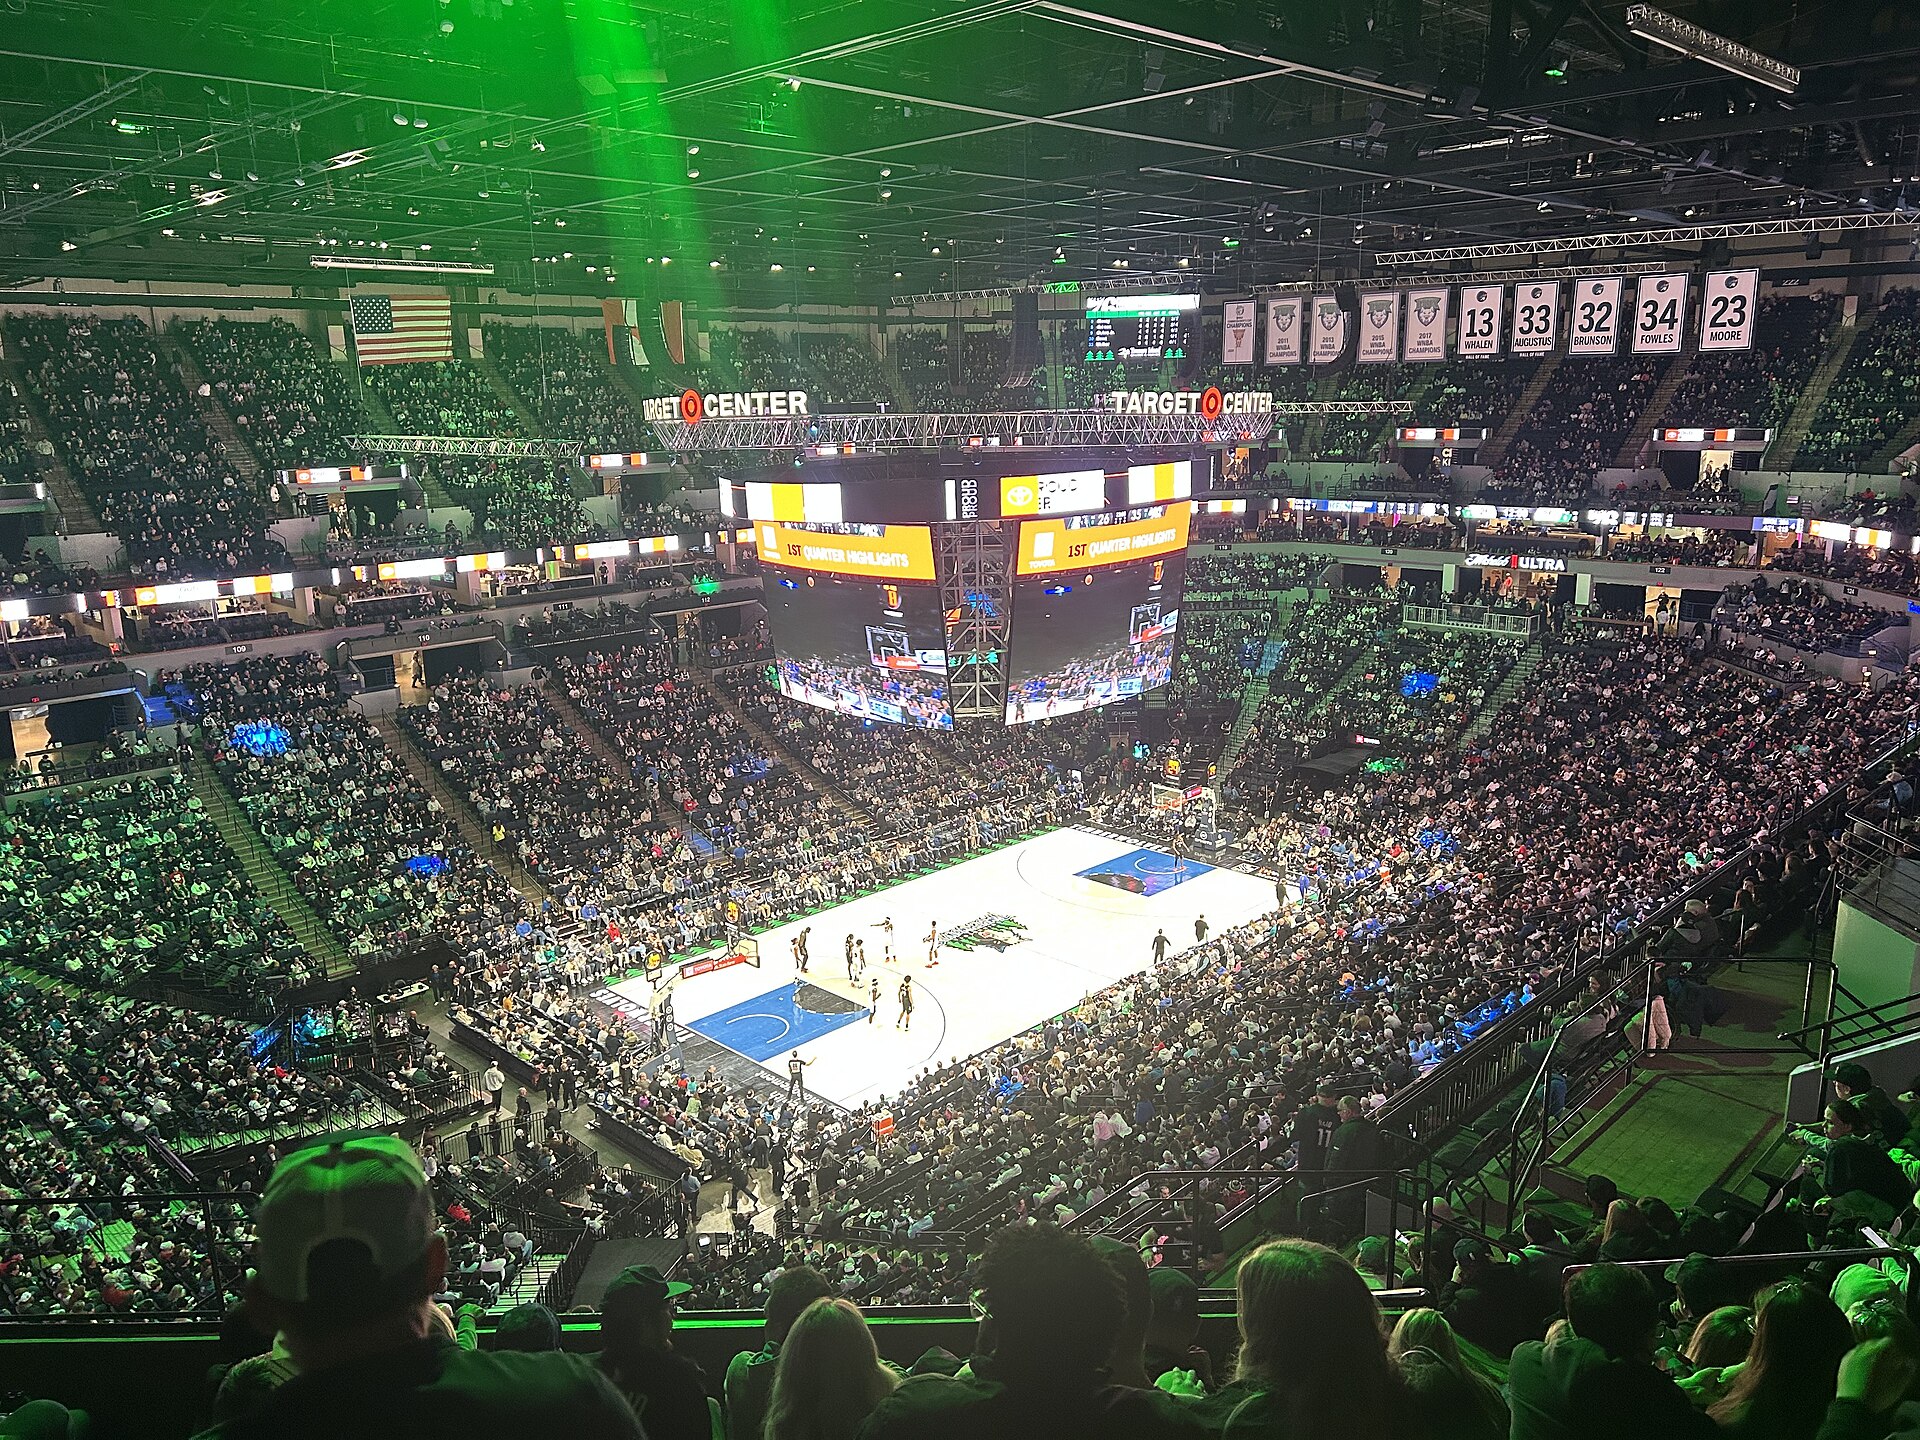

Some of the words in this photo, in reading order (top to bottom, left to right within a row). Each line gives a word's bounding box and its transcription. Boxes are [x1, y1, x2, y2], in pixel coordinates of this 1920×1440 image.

[1577, 301, 1612, 333] 32
[1639, 298, 1678, 332] 34
[1708, 295, 1747, 328] 23
[1465, 308, 1494, 338] 13
[1518, 305, 1551, 335] 33
[1514, 336, 1552, 347] AUGUSTUS
[1573, 335, 1612, 346] BRUNSON
[1640, 333, 1674, 345] FOWLES
[1709, 331, 1742, 341] MOORE
[1362, 348, 1393, 356] CHAMPIONS
[1464, 339, 1493, 350] WHALEN
[703, 390, 808, 417] CENTER
[1112, 390, 1202, 415] TARGET
[1222, 391, 1273, 414] CENTER
[1097, 513, 1110, 525] 26
[1130, 508, 1142, 520] 35
[1068, 543, 1087, 557] 1ST
[1089, 536, 1131, 558] QUARTER
[1131, 528, 1177, 549] HIGHLIGHTS
[787, 543, 802, 557] 1ST
[803, 544, 846, 564] QUARTER
[847, 550, 909, 568] HIGHLIGHTS
[1519, 556, 1566, 572] ULTRA
[417, 634, 430, 642] 110
[232, 645, 246, 653] 109
[1317, 1128, 1332, 1147] 11
